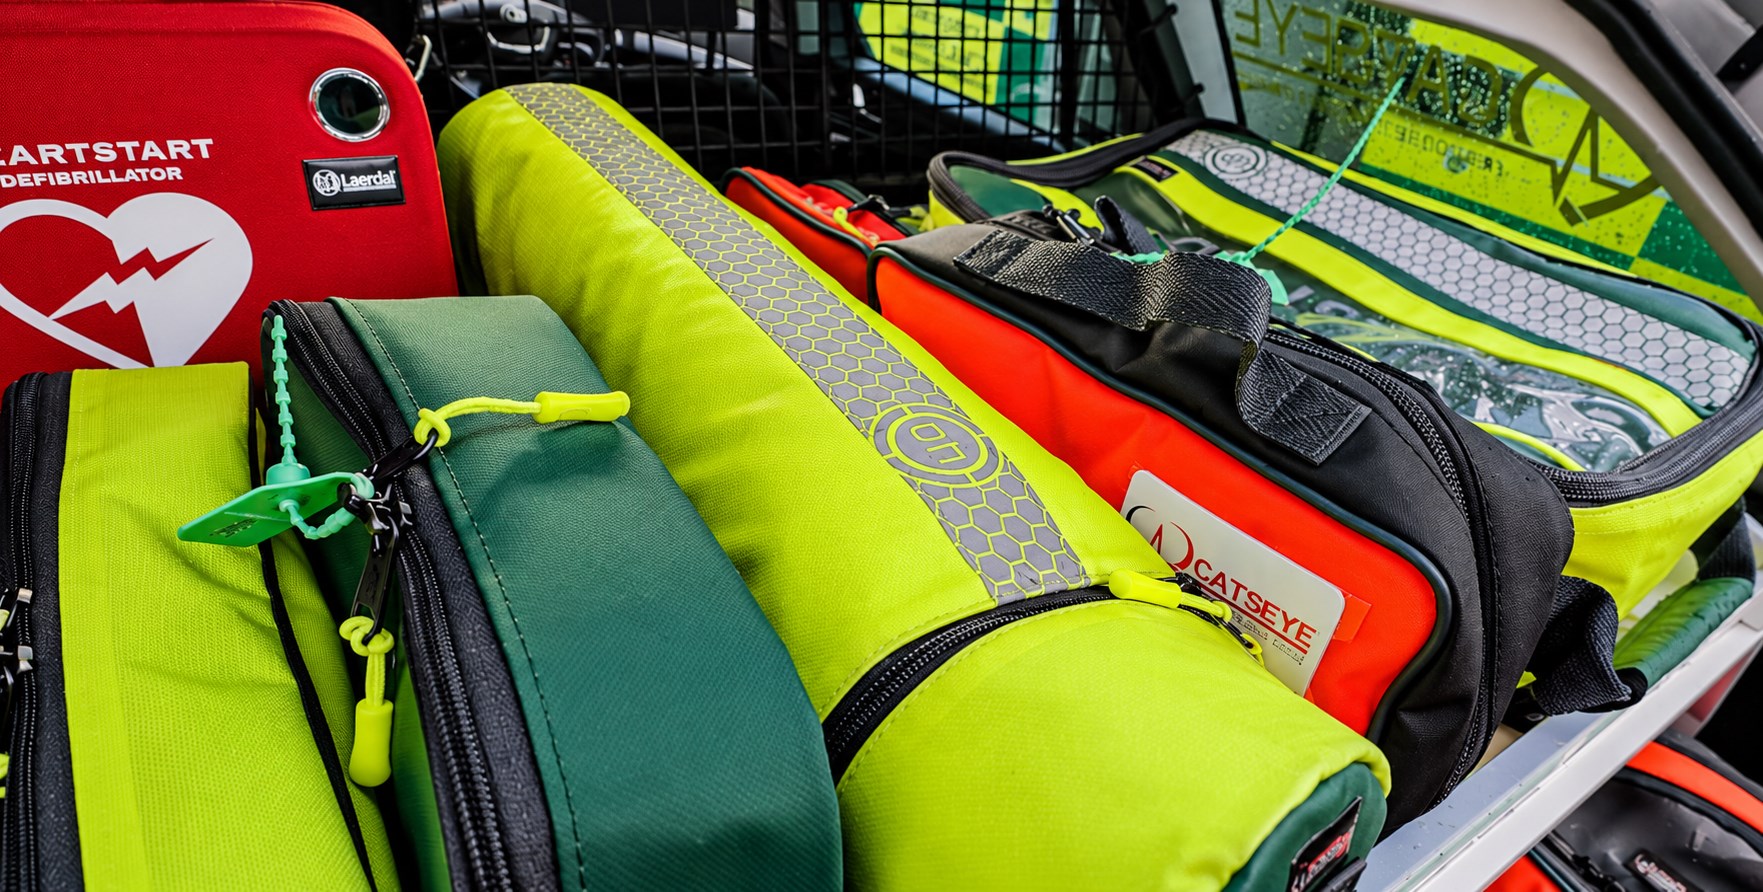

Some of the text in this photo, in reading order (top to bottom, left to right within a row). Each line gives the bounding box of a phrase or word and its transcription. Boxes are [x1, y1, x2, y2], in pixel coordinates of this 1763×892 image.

[0, 166, 183, 189] DEFIBRILLATOR
[340, 169, 395, 187] Laerdal
[1194, 558, 1317, 649] CATSEYE
